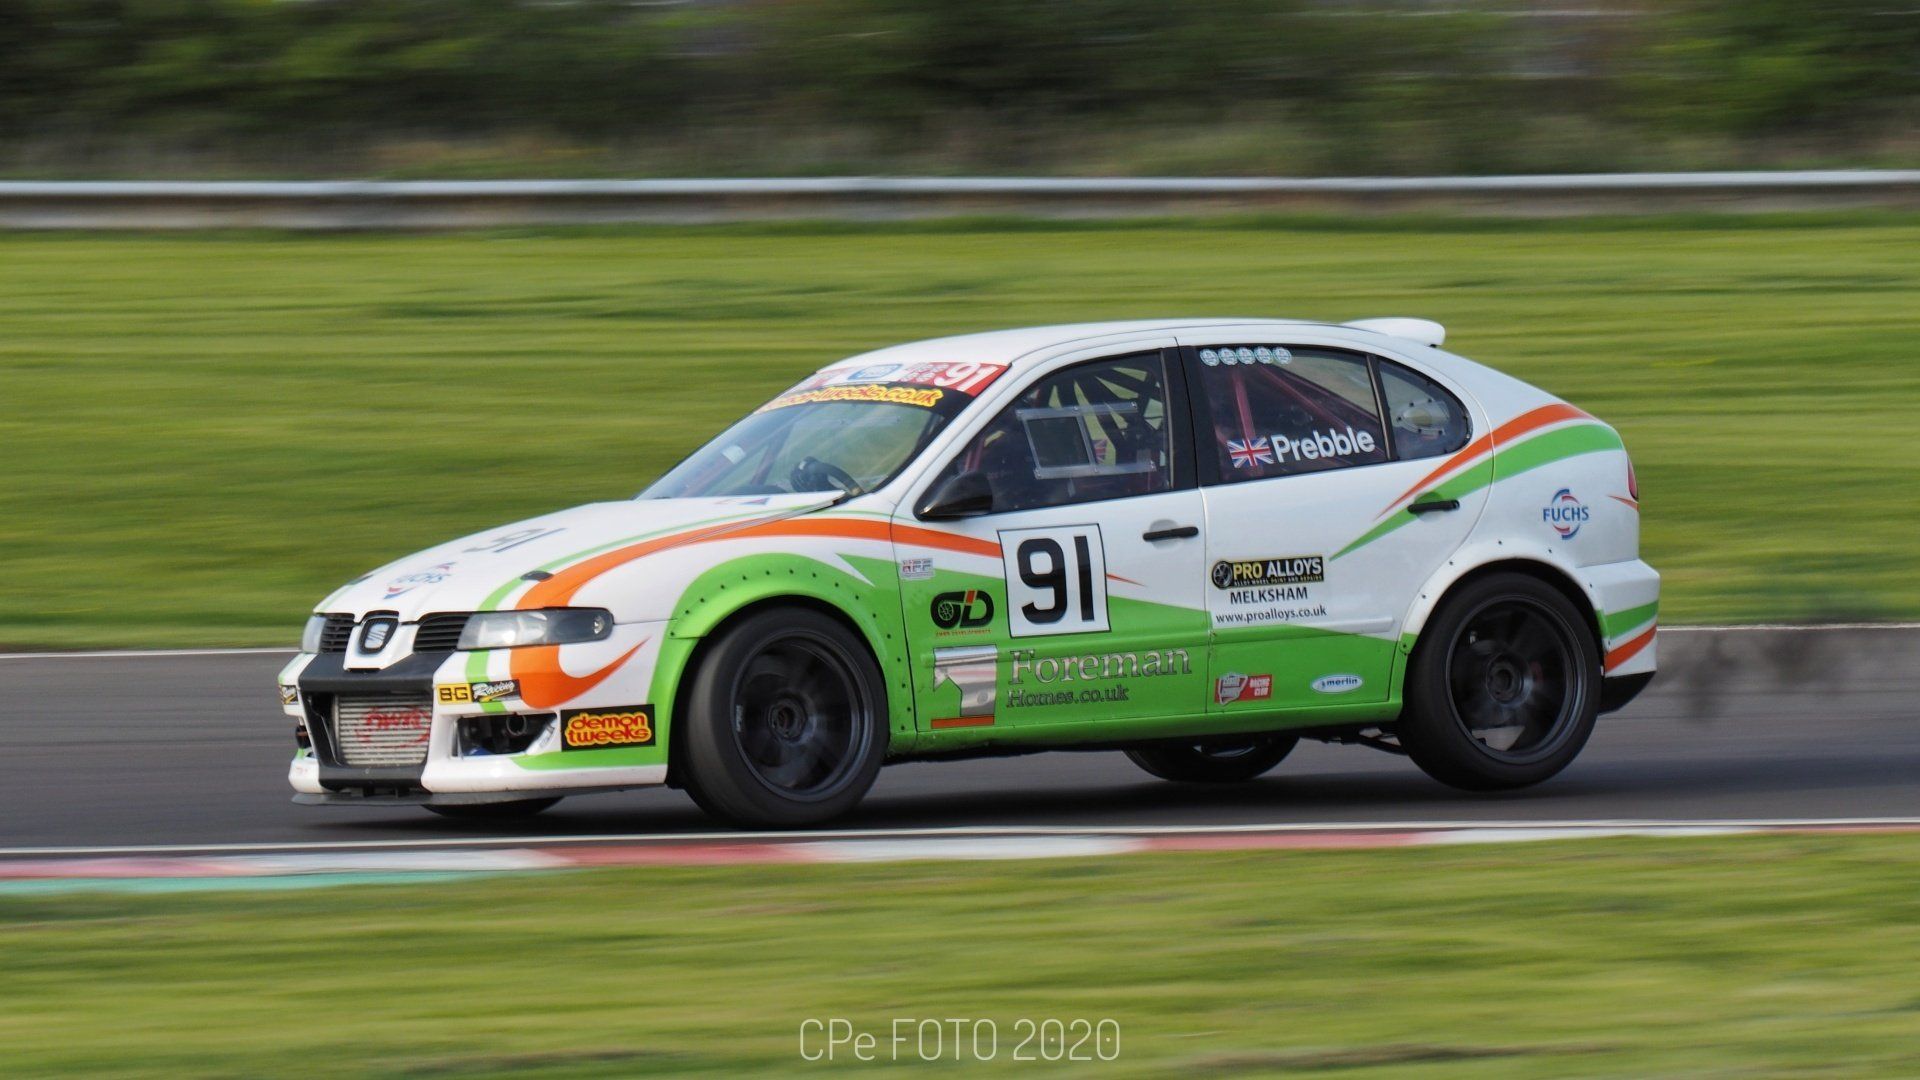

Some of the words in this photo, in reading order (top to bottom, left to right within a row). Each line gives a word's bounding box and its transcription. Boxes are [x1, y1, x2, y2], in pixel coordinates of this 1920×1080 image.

[934, 361, 1000, 391] 91
[1271, 427, 1376, 463] Prebble
[1542, 506, 1590, 522] FUCHS
[1017, 535, 1095, 625] 91
[1233, 562, 1262, 581] PRO
[1266, 557, 1322, 578] ALLOYS
[1230, 587, 1308, 605] MELKSHAM
[1216, 604, 1327, 623] www.proalloys.co.uk
[1008, 648, 1192, 685] Foreman
[1006, 684, 1130, 708] Homes.co.uk
[570, 713, 646, 730] demon
[567, 727, 650, 744] tweeks
